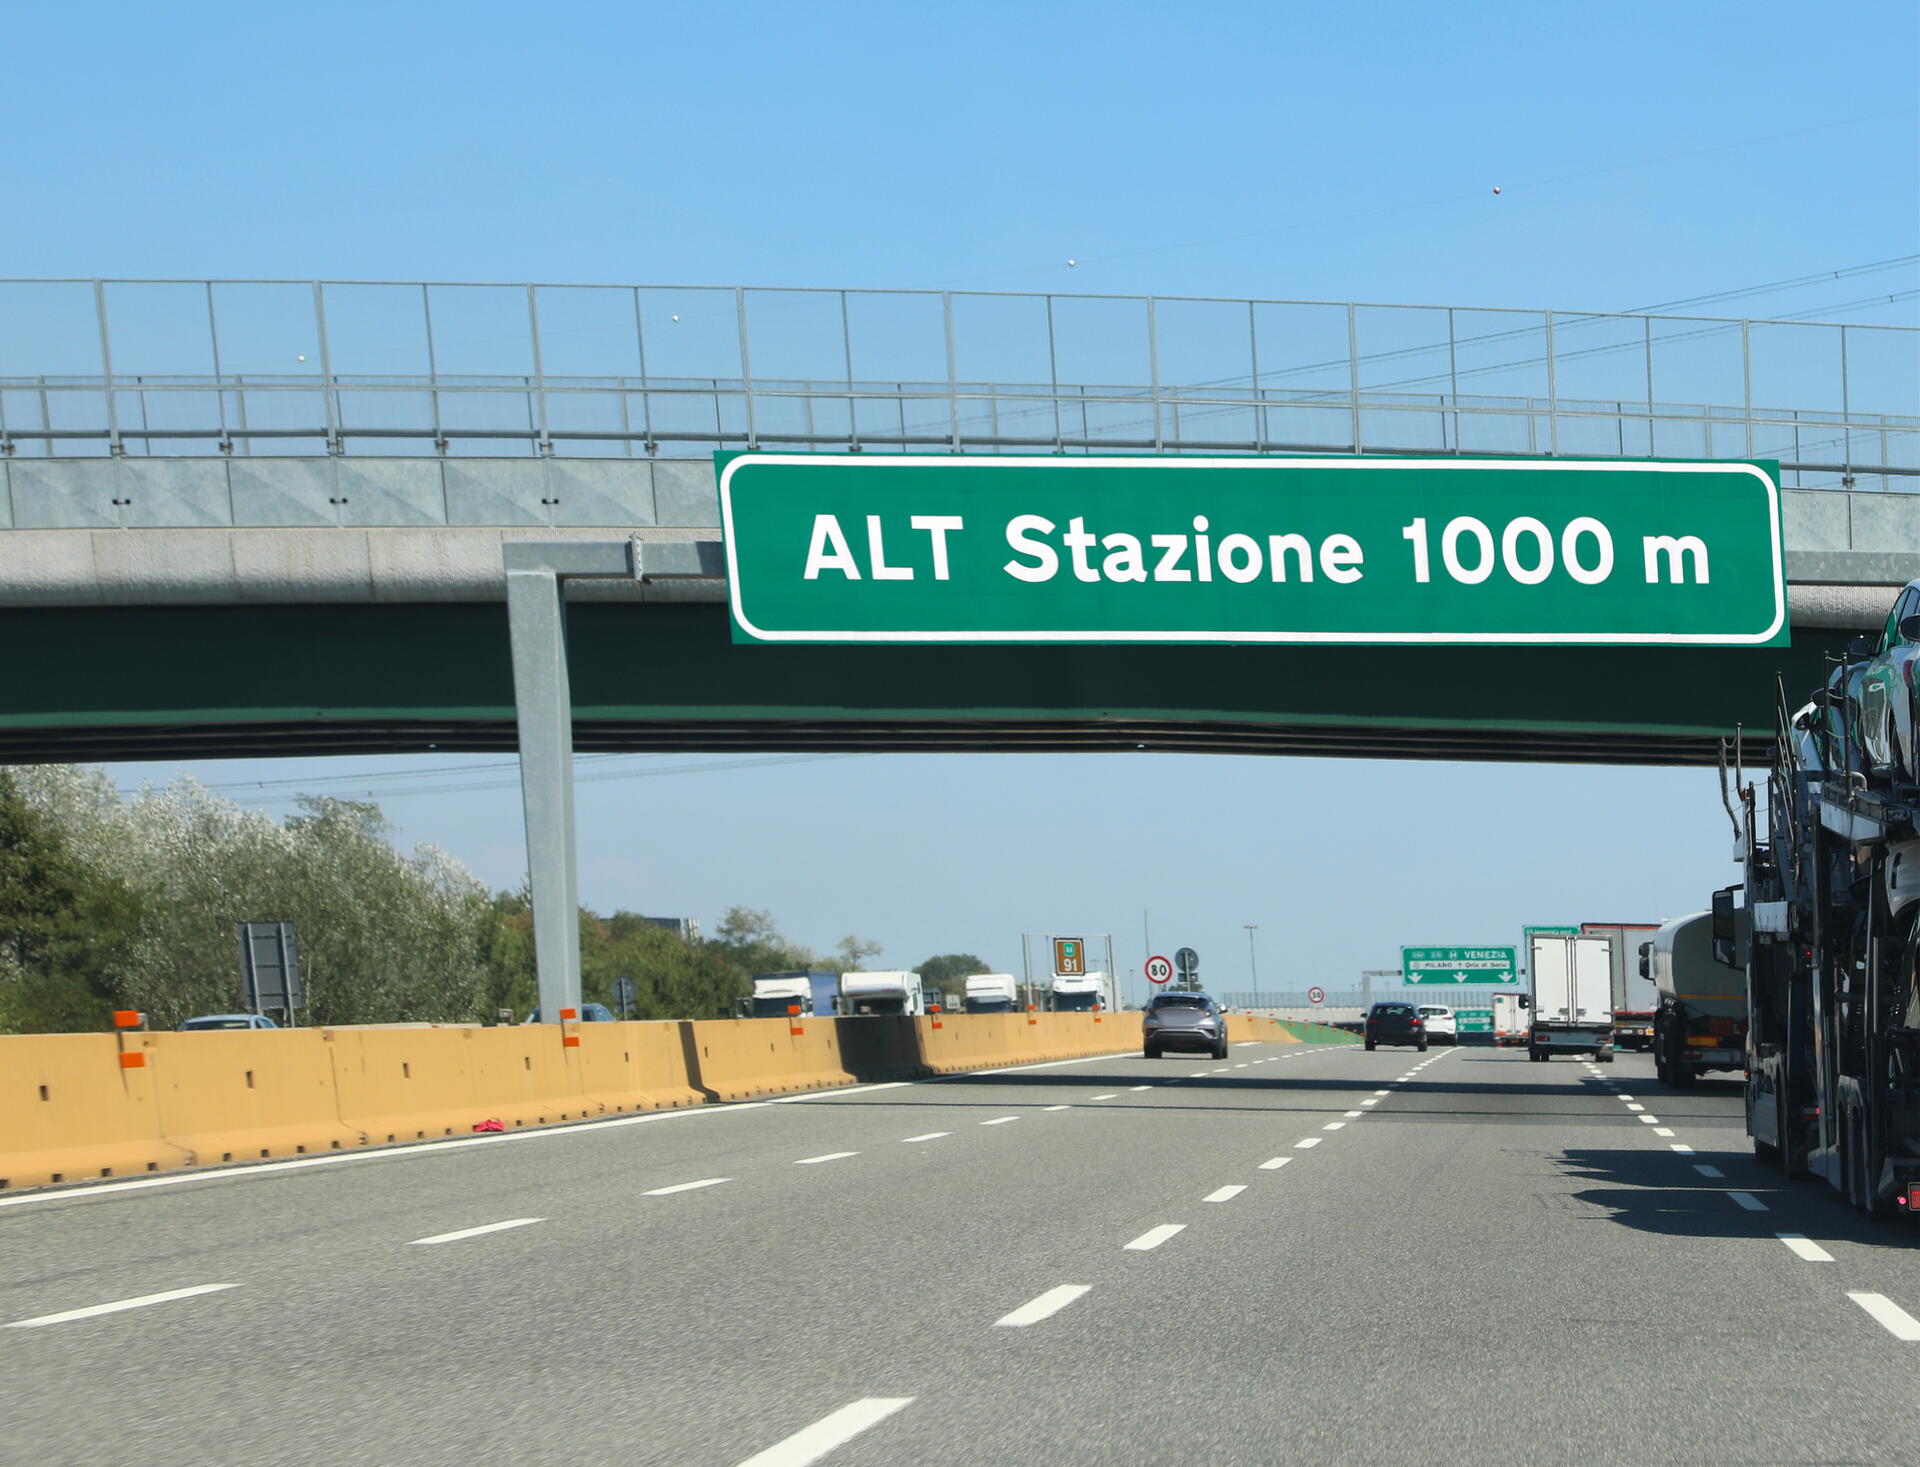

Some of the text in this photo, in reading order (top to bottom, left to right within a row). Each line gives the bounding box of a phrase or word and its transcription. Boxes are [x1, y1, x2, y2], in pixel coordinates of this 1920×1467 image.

[803, 514, 1710, 586] ALT Stazione 1000 m
[1464, 950, 1508, 959] VENEZIA
[1063, 958, 1078, 972] 91
[1151, 964, 1167, 976] 80
